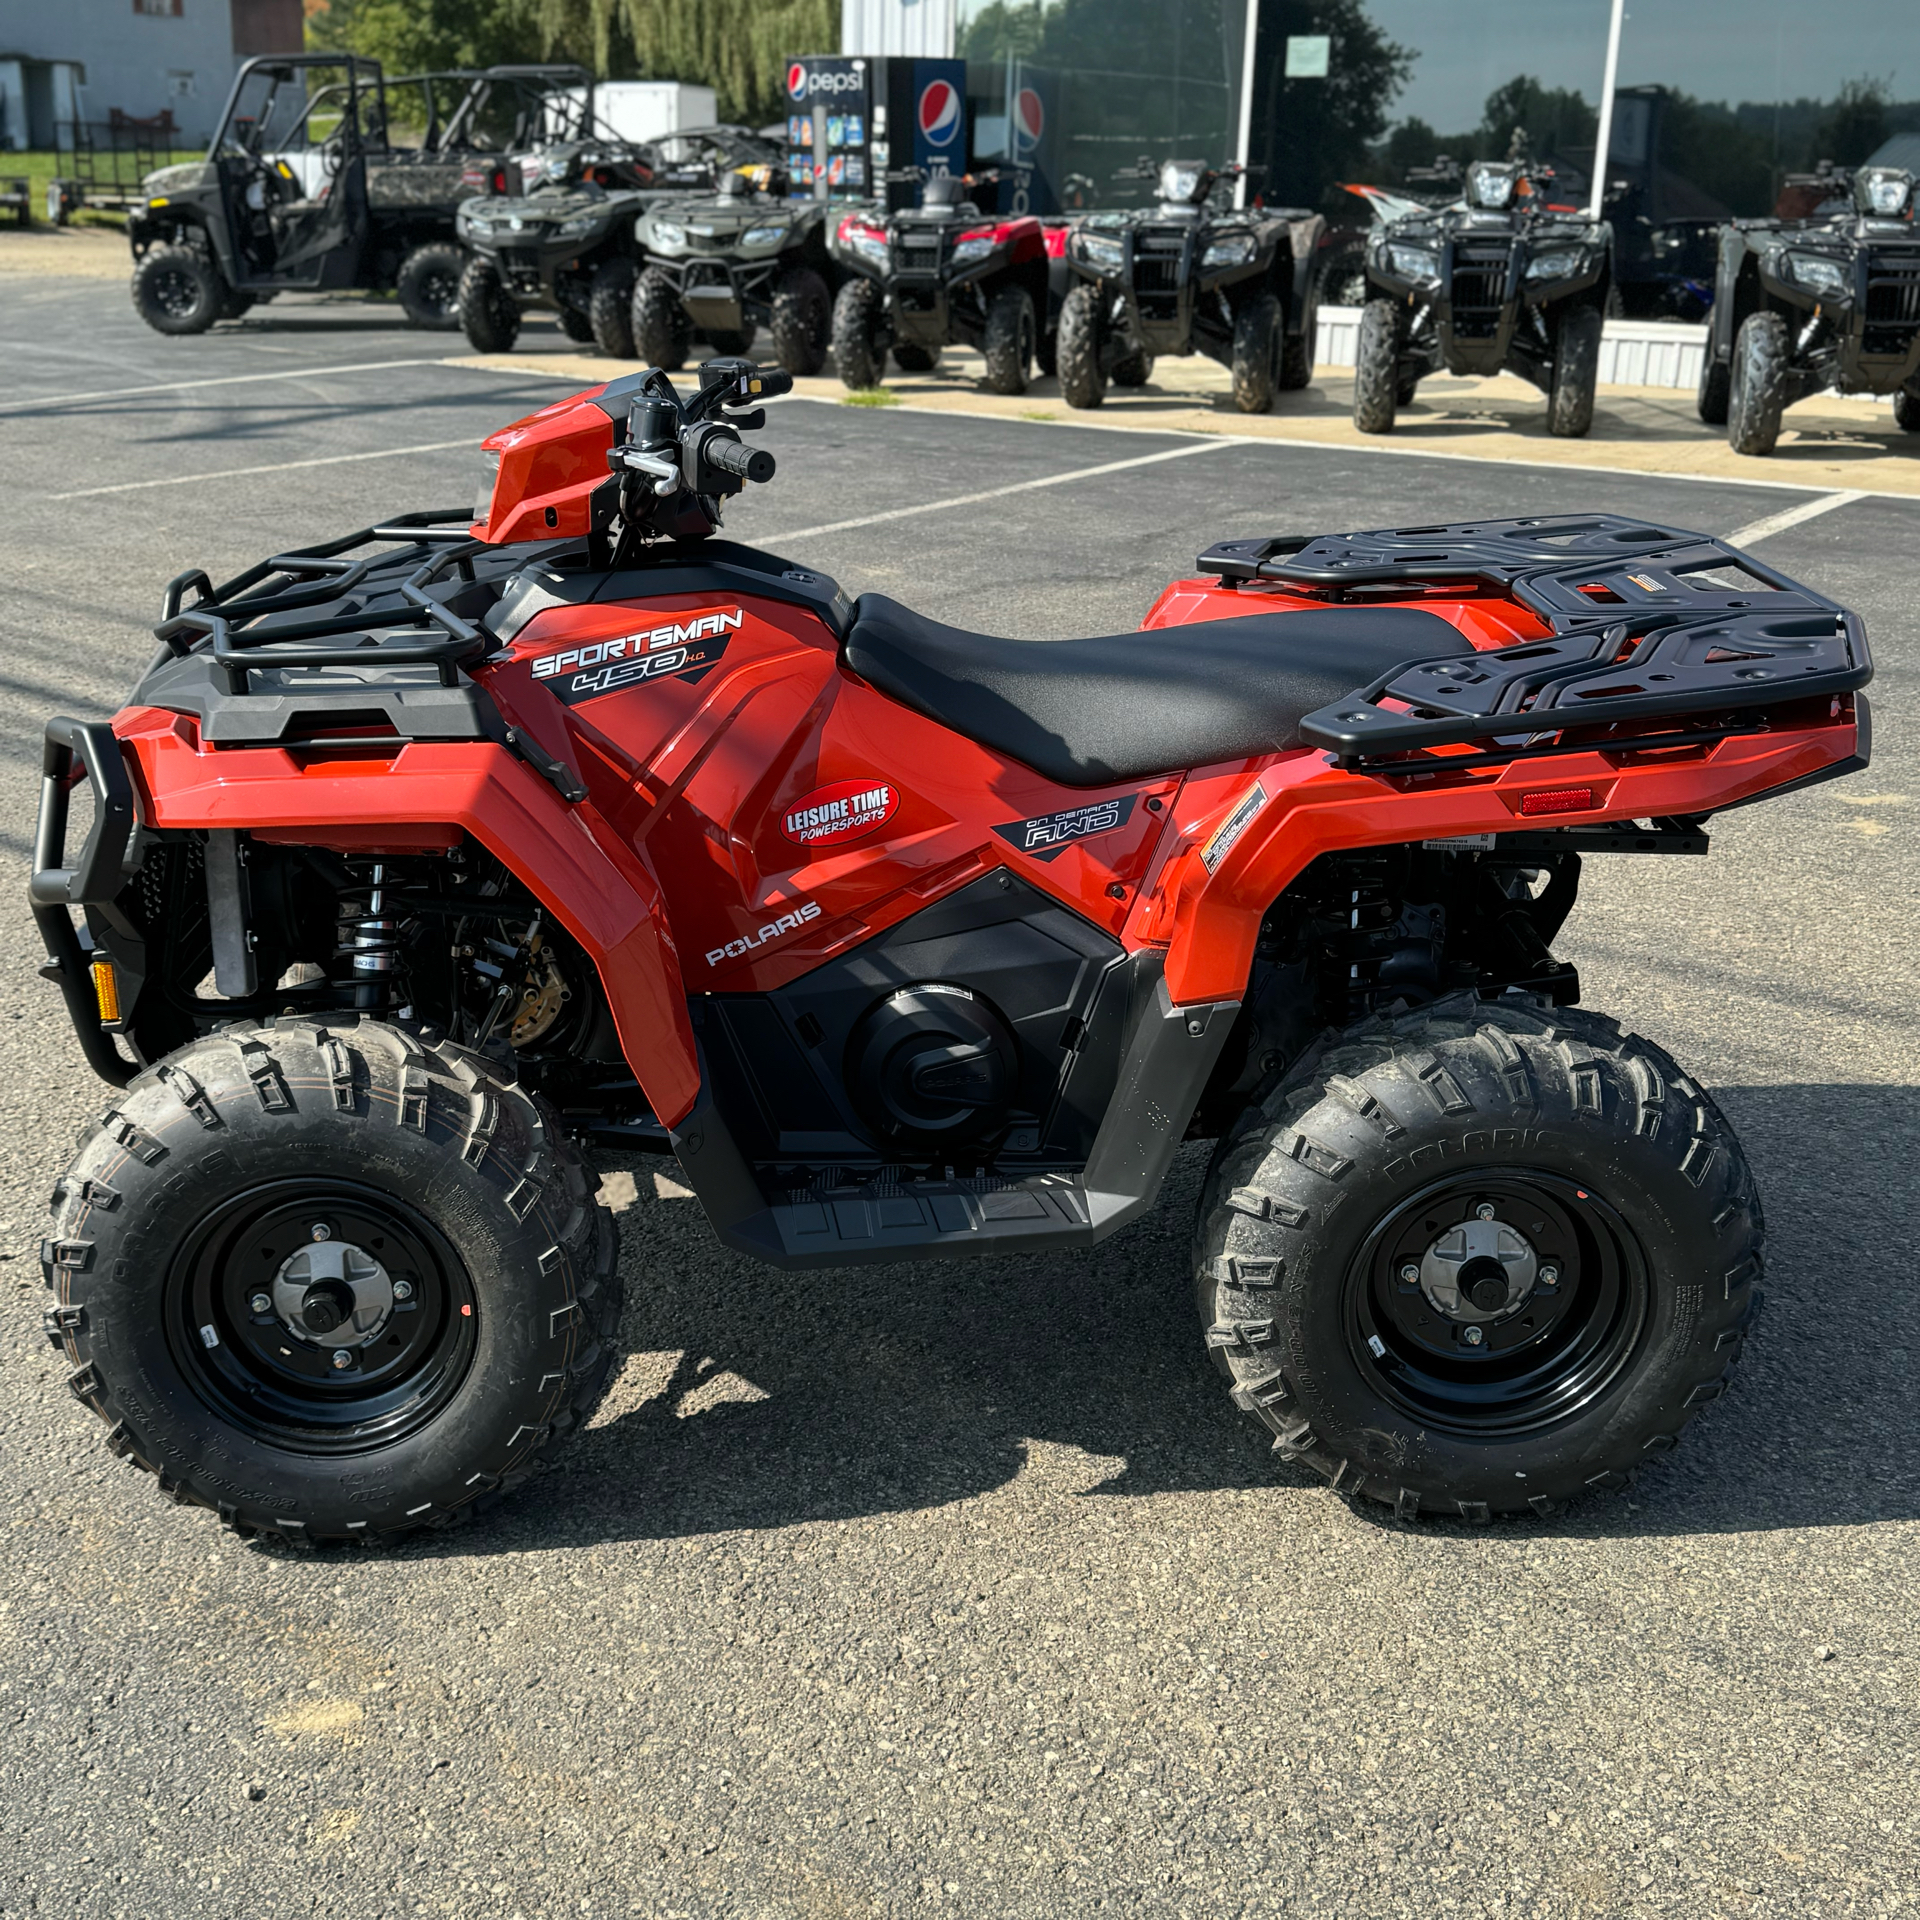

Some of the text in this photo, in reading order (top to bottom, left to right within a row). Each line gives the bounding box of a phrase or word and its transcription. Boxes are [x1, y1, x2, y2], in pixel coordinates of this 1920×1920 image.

[808, 65, 864, 96] pepsi
[531, 609, 744, 679] SPORTSMAN
[571, 647, 688, 692] 450
[786, 786, 890, 834] LEISURE TIME
[800, 807, 886, 843] POWERSPORTS
[1025, 809, 1119, 848] AWD
[1026, 800, 1120, 829] ON DEMAND
[705, 901, 822, 967] POLARIS
[1383, 1128, 1566, 1184] POLARIS
